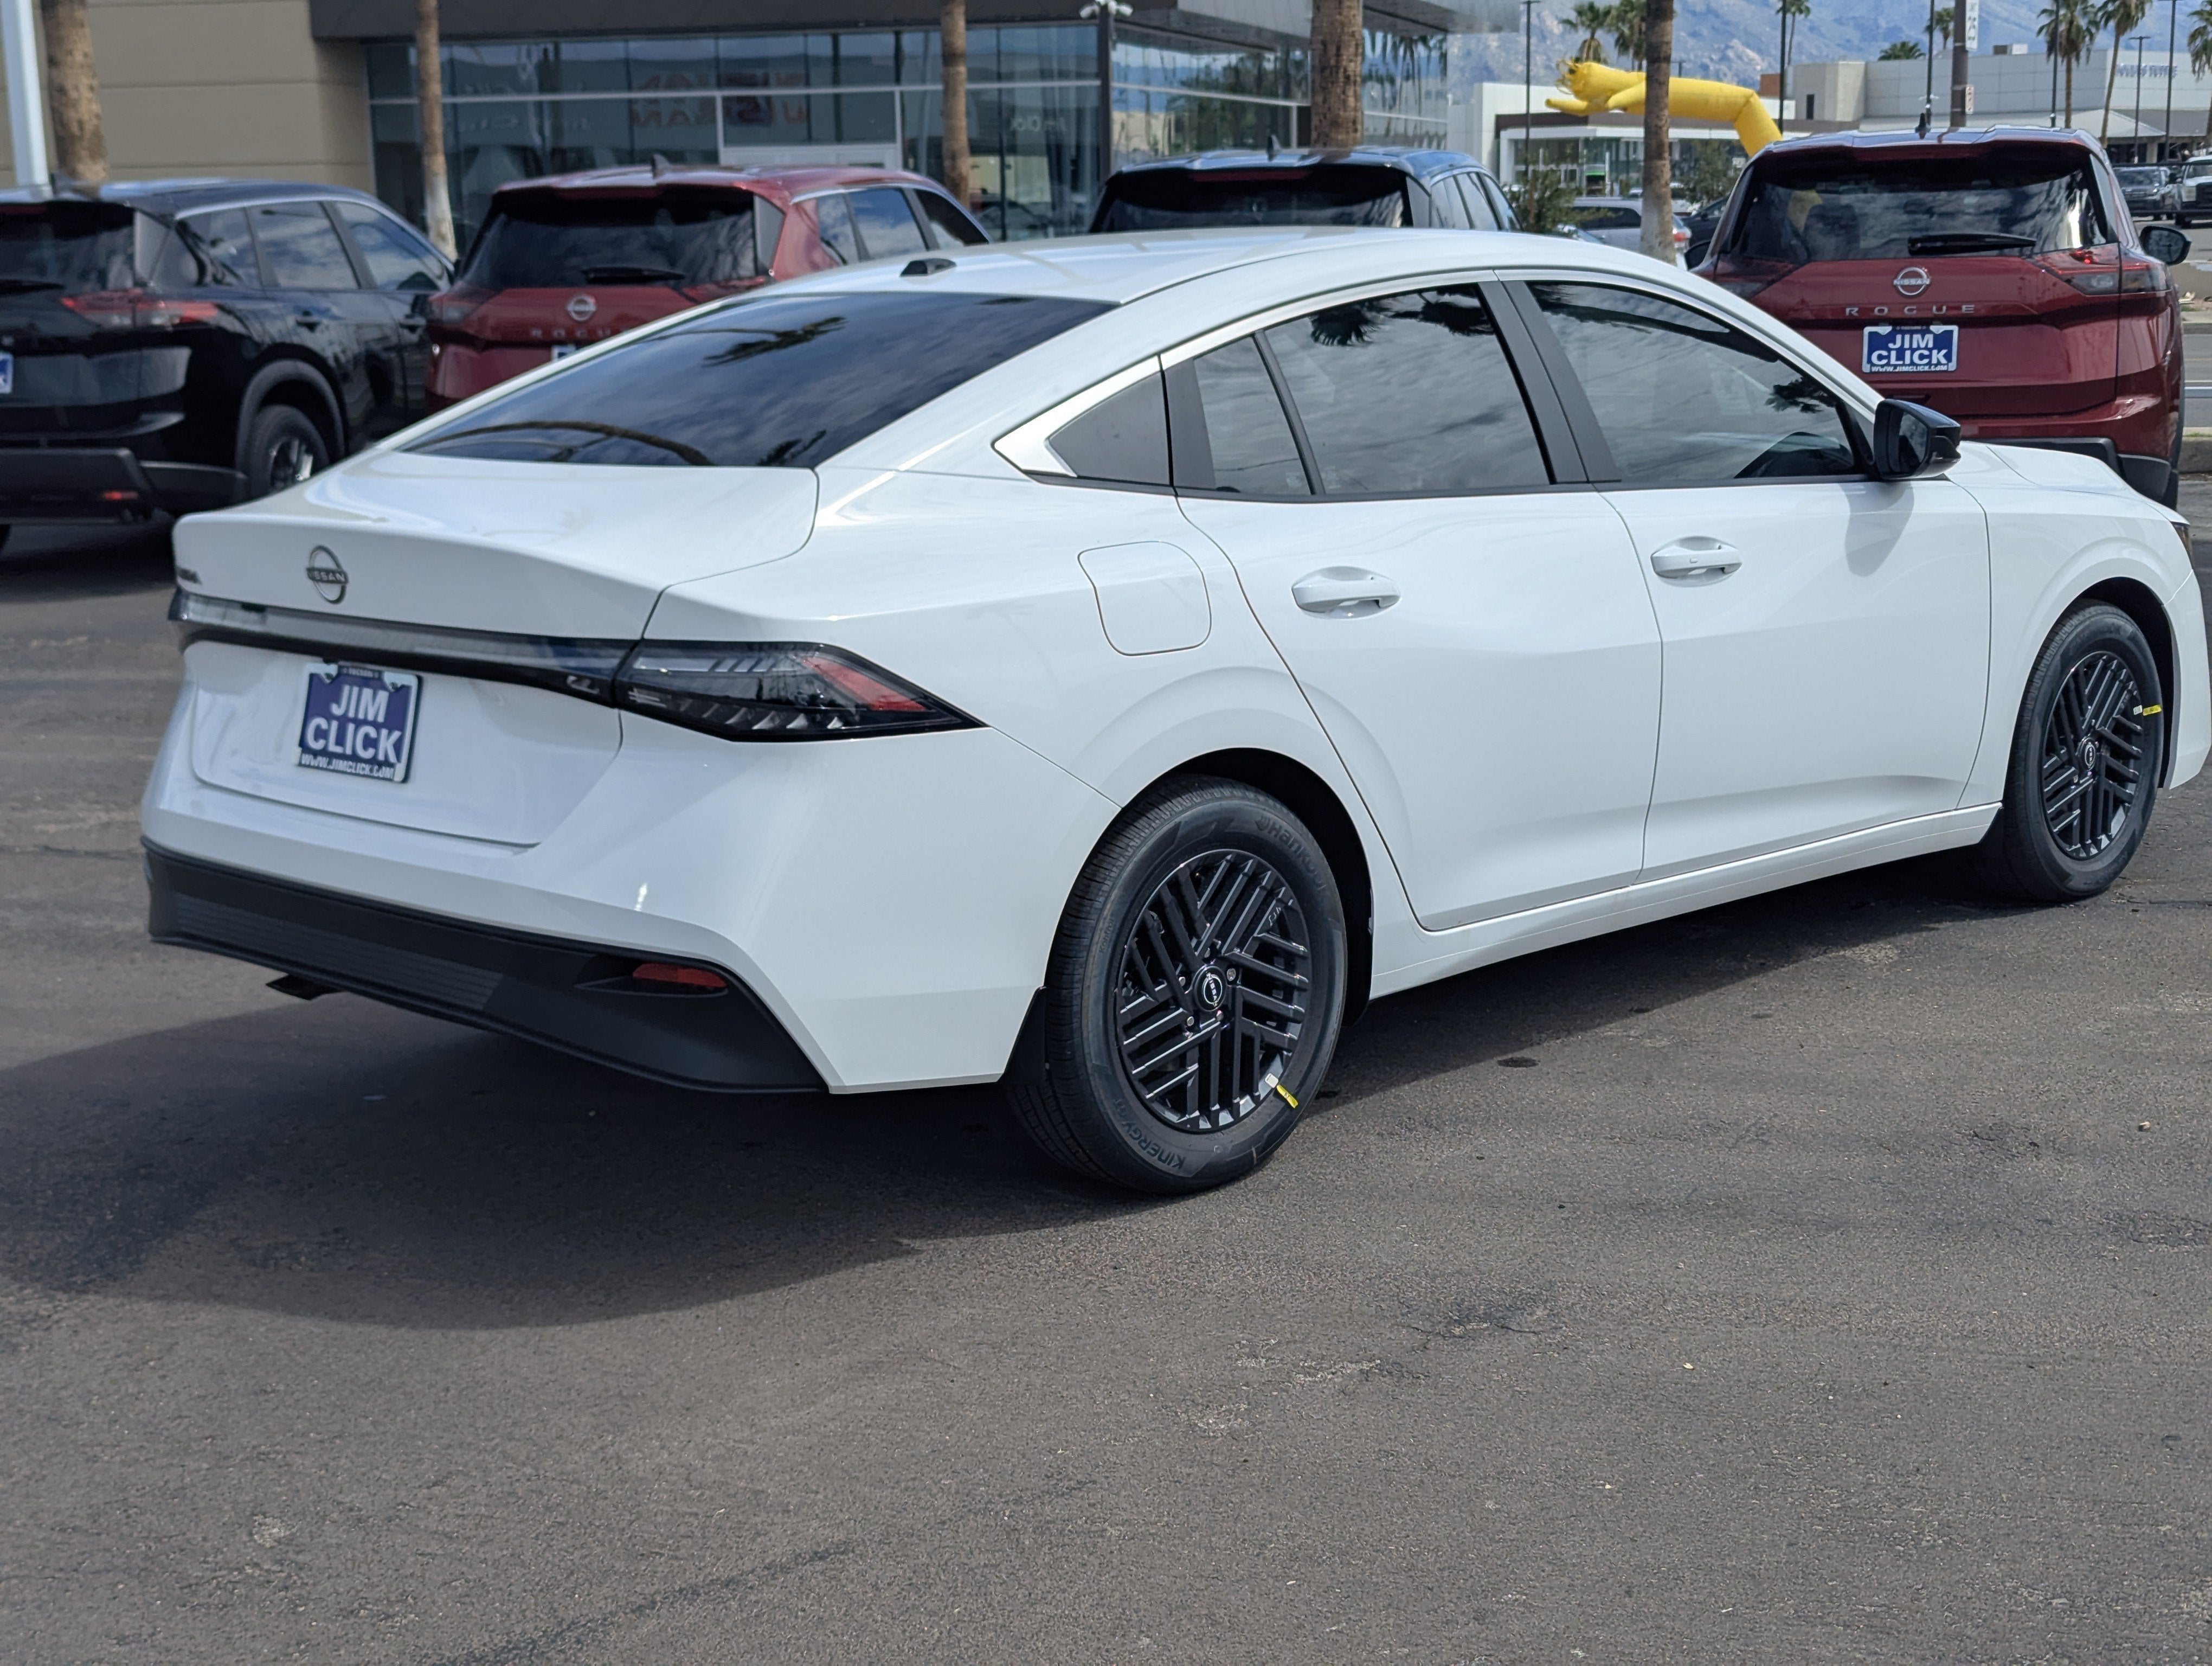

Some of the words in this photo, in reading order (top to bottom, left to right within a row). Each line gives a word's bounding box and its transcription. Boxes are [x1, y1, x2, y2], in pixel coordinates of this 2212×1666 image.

[1846, 305, 1975, 316] ROGUE
[1888, 334, 1934, 348] JIM
[1871, 349, 1948, 365] CLICK
[331, 684, 389, 723] JIM
[306, 717, 402, 764] CLICK
[1121, 1121, 1186, 1170] KINERGY
